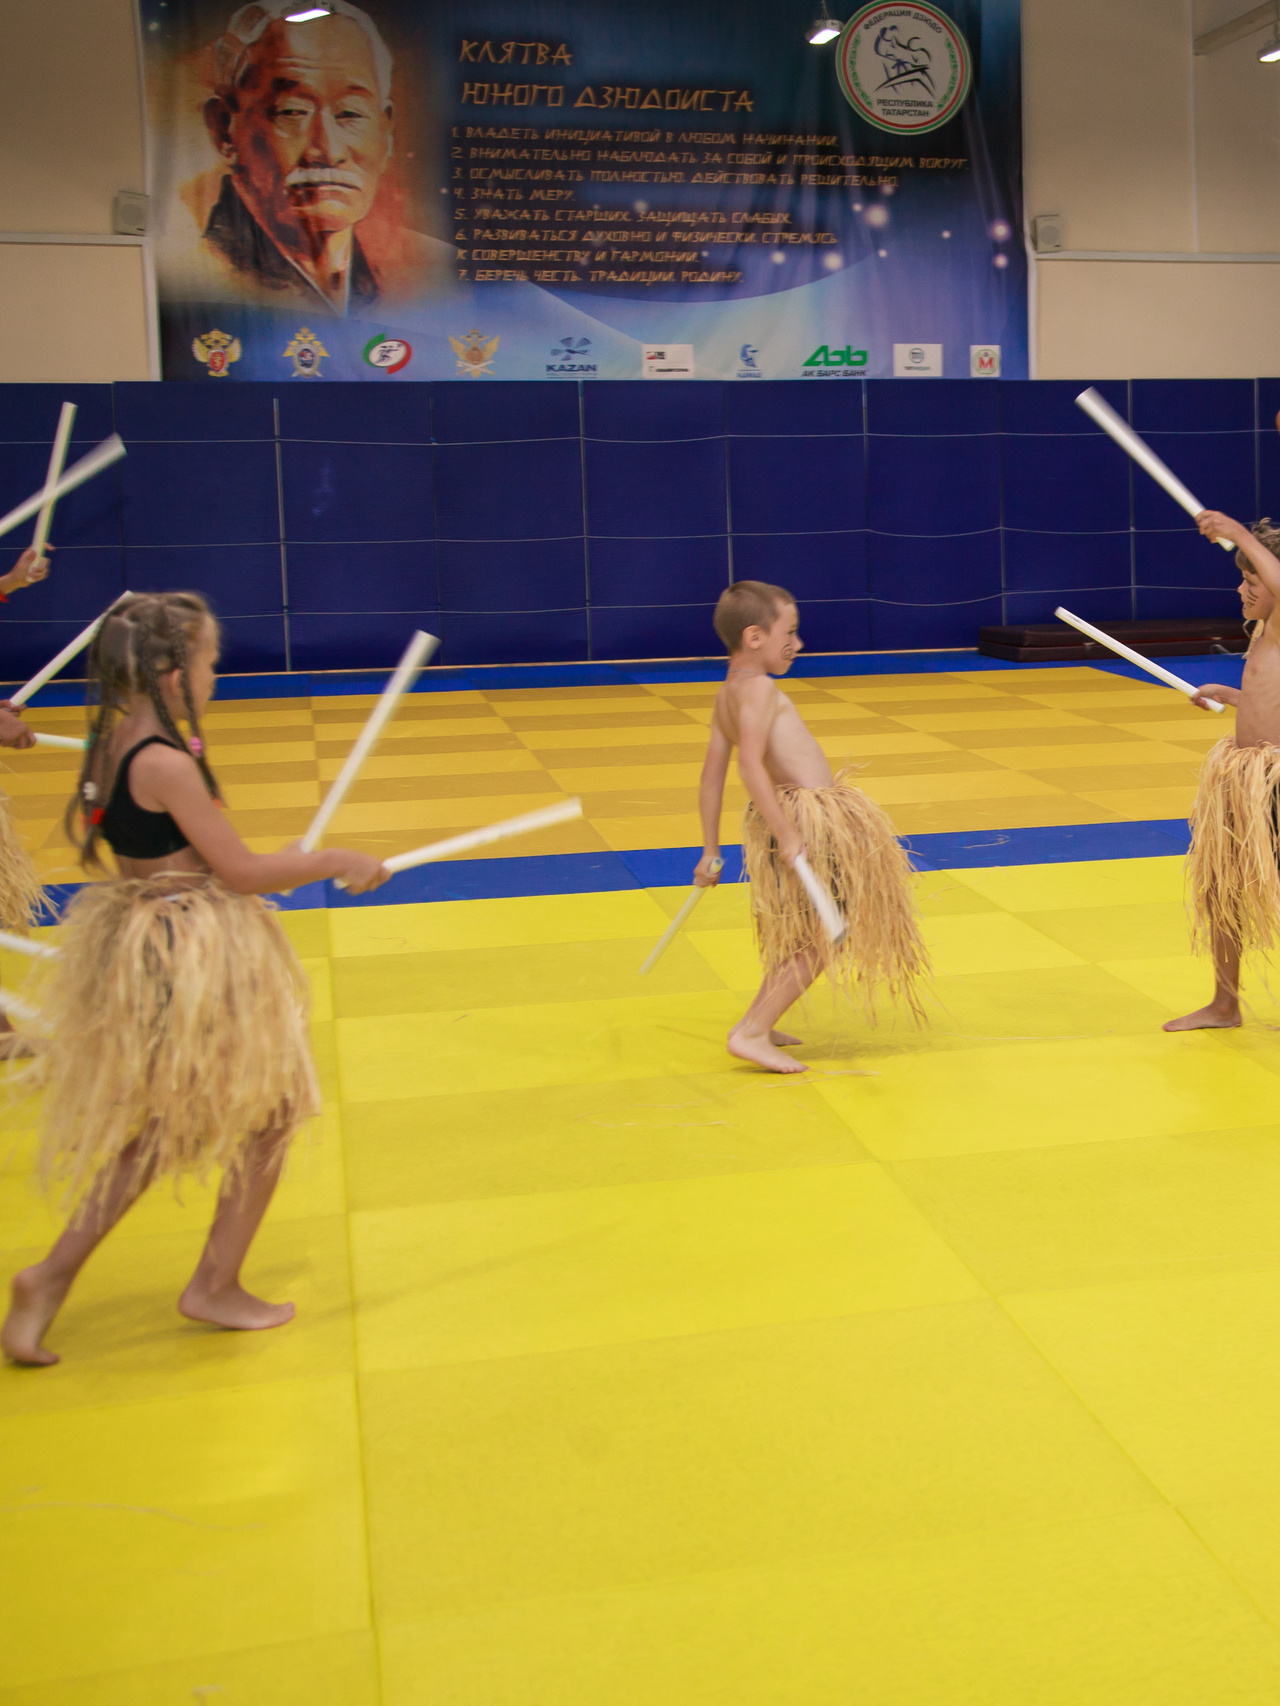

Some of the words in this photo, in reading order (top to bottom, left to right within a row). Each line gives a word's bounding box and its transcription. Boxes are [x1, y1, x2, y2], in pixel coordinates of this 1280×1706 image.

[863, 10, 912, 30] ФЕДЕРАЦИЯ
[912, 11, 942, 34] ДЗЮДО
[459, 40, 572, 66] КЛЯТВА
[461, 82, 564, 107] ЮНОГО
[573, 86, 754, 112] ДЗЮДОИСТА
[877, 98, 933, 108] РЕСПУБЛИКА
[882, 108, 930, 117] ТАТАРСТАН
[466, 127, 539, 140] ВЛАДЕТЬ
[545, 128, 661, 145] ИНИЦИАТИВОЙ
[665, 132, 673, 143] В
[678, 132, 737, 144] ЛЮБОМ
[469, 147, 592, 161] ВНИМАТЕЛЬНО
[597, 150, 697, 163] НАБЛЮДАТЬ
[702, 152, 722, 164] ЗА
[727, 151, 773, 165] СОБОЙ
[776, 154, 787, 165] И
[793, 154, 915, 171] ПРОИСХОДЯЩИМ
[469, 168, 584, 181] ОСМЫСЛИВАТЬ
[691, 170, 795, 185] ДЕЙСТВОВАТЬ
[471, 188, 523, 200] ЗНАТЬ
[473, 208, 549, 221] УВАЖАТЬ
[637, 210, 727, 227] ЗАЩИЩАТЬ
[473, 229, 579, 242] РАЗВИВАТЬСЯ
[581, 230, 651, 242] ДУХОВНО
[655, 231, 668, 243] И
[455, 250, 467, 261] К
[472, 249, 591, 262] СОВЕРШЕНСТВУ
[594, 250, 607, 262] И
[474, 269, 530, 282] БЕРЕЧЬ
[545, 364, 597, 372] KAZAN
